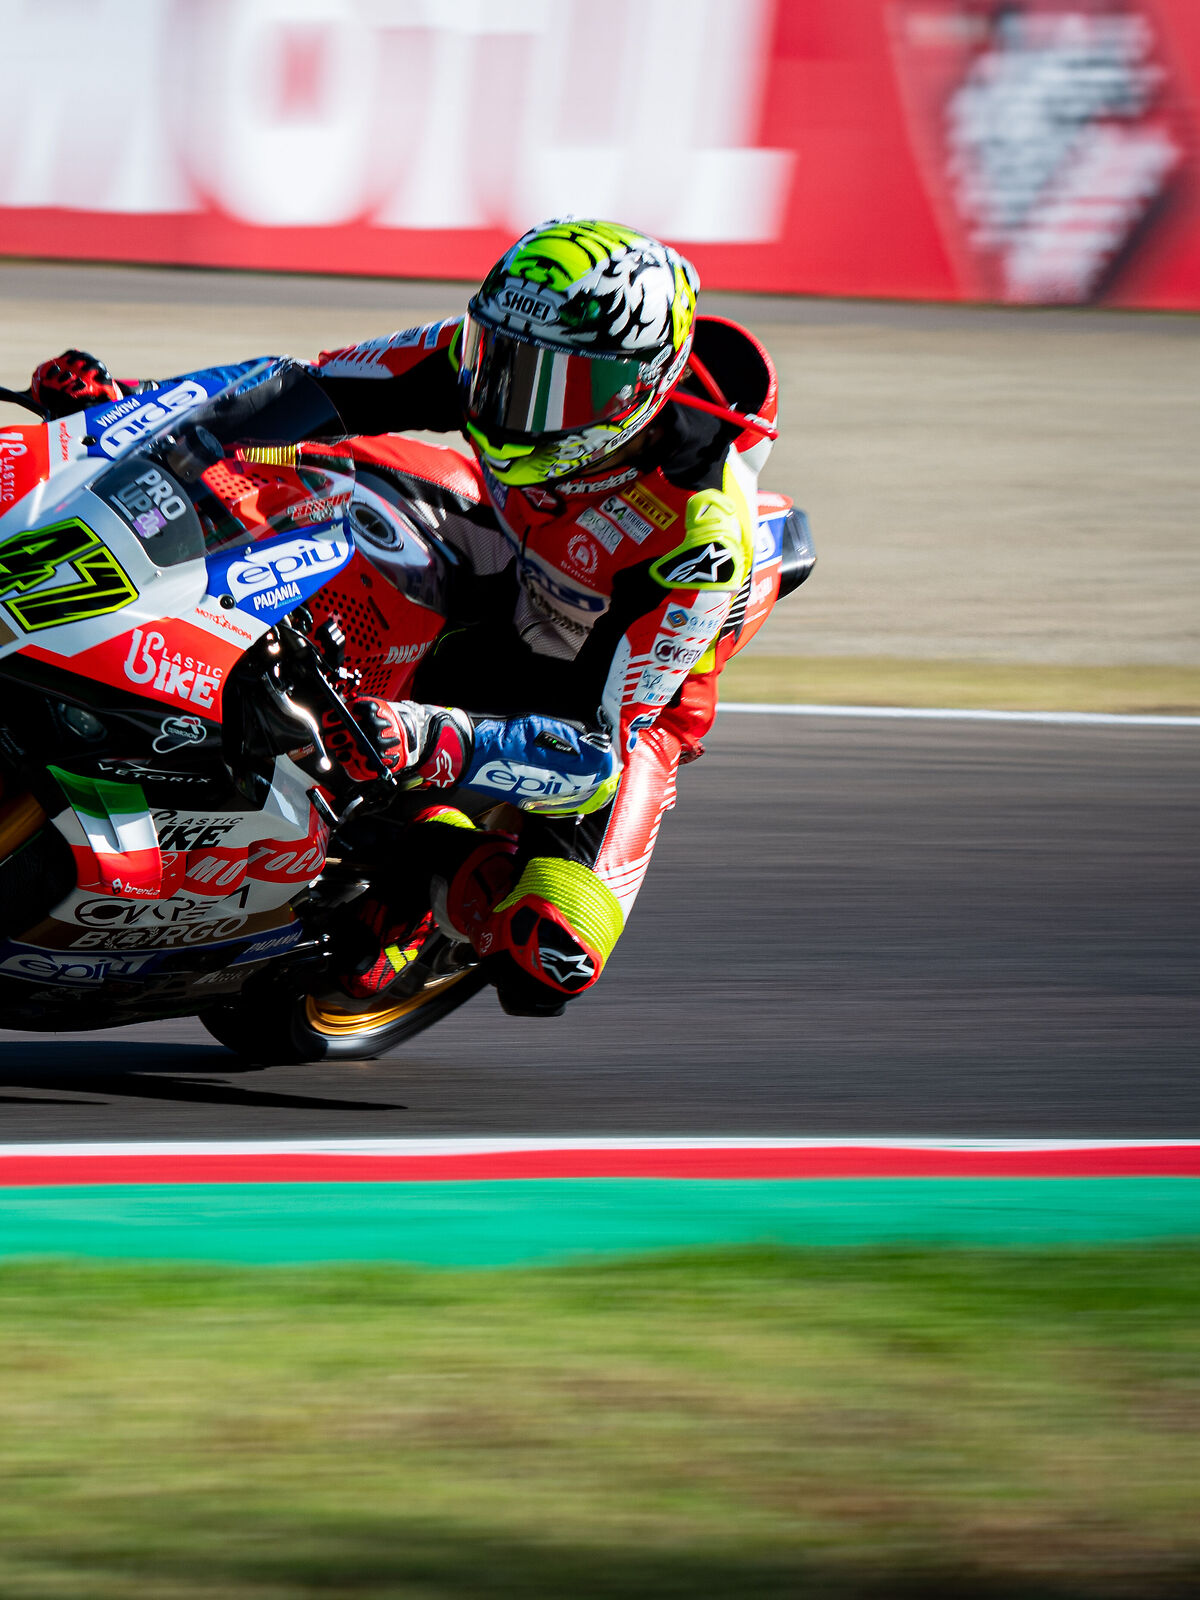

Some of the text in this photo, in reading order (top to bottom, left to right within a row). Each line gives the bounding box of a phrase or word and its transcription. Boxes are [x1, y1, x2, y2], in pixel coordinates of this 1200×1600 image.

[501, 290, 551, 320] SHOEI
[117, 482, 153, 513] UP
[134, 469, 186, 520] PRO
[237, 541, 341, 584] epiu
[253, 581, 301, 611] PADANIA
[154, 825, 236, 851] IKE
